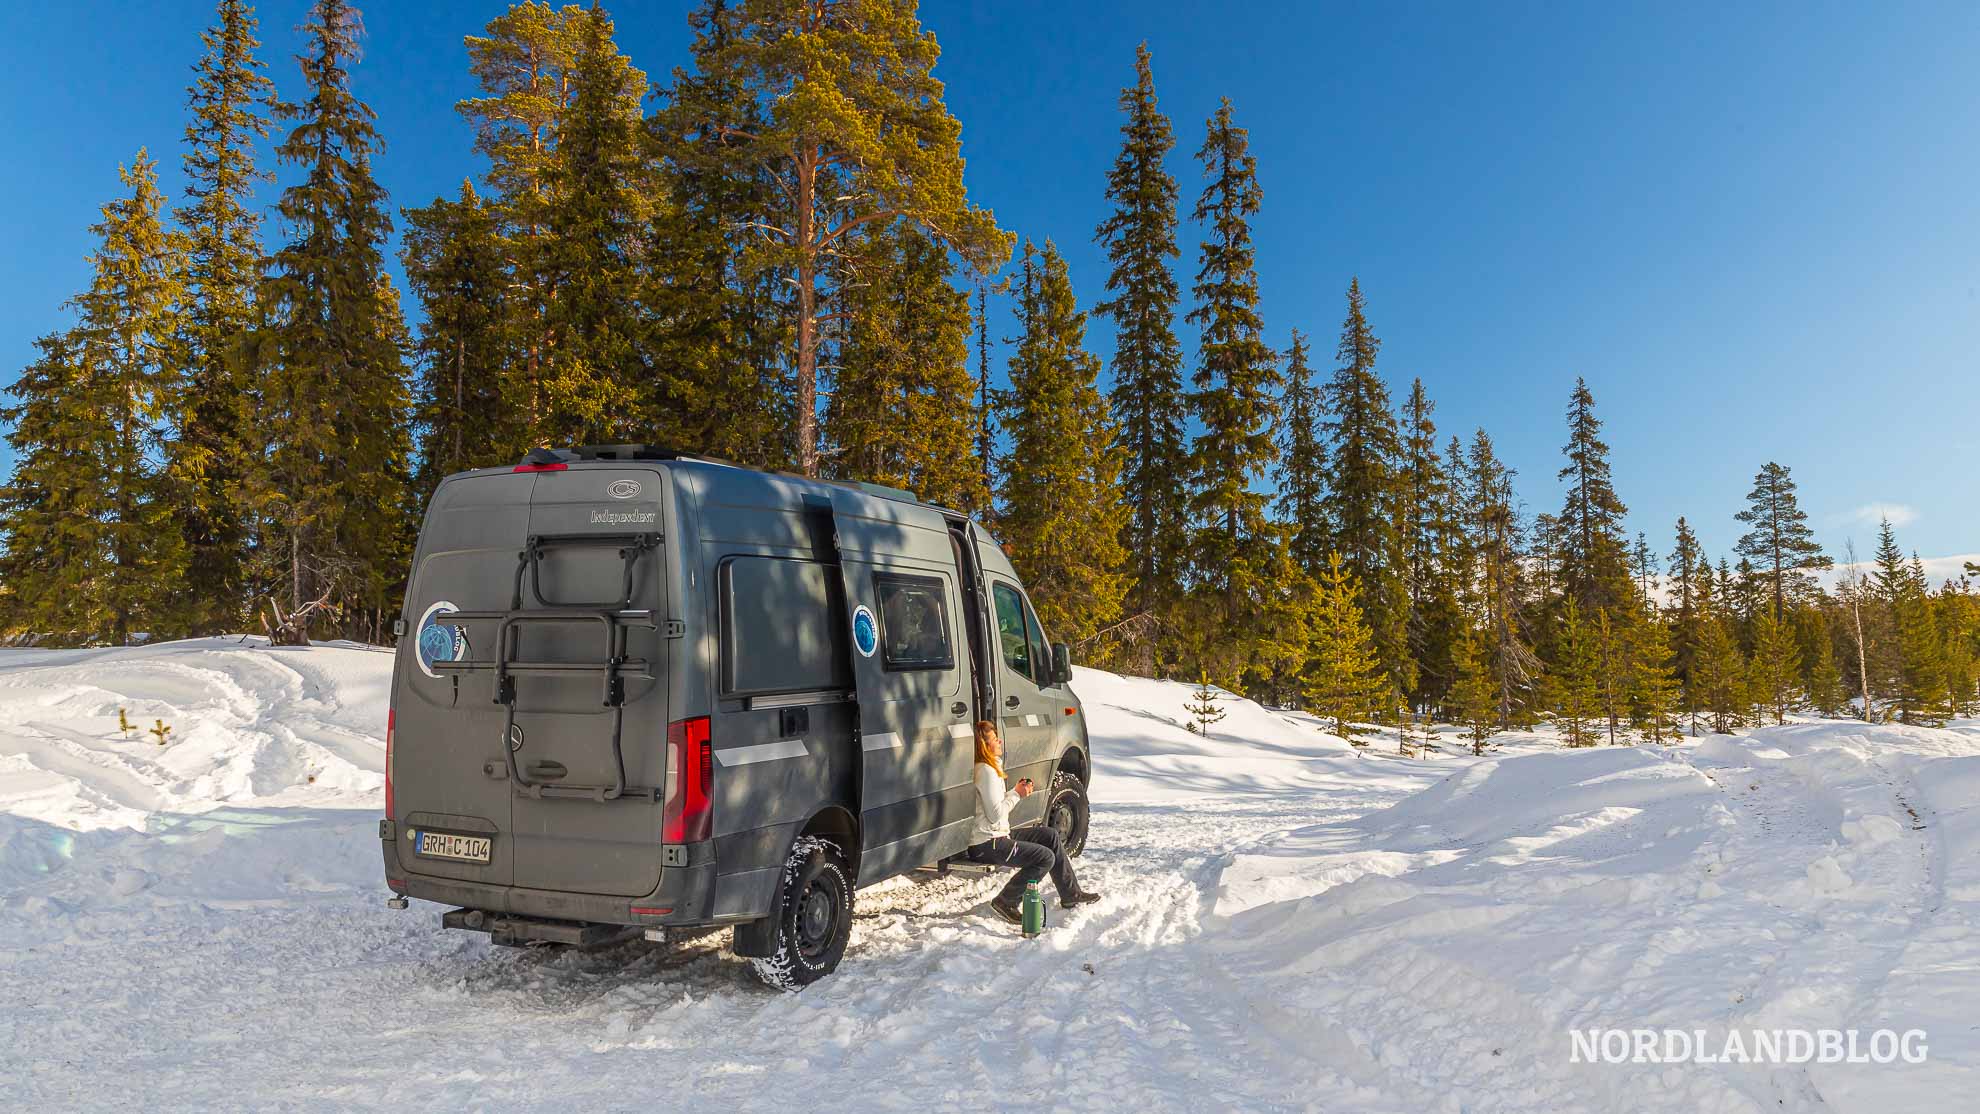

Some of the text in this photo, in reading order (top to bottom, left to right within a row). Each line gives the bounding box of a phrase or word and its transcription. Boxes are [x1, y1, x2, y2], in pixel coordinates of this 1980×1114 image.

[422, 834, 488, 858] GRH C 104
